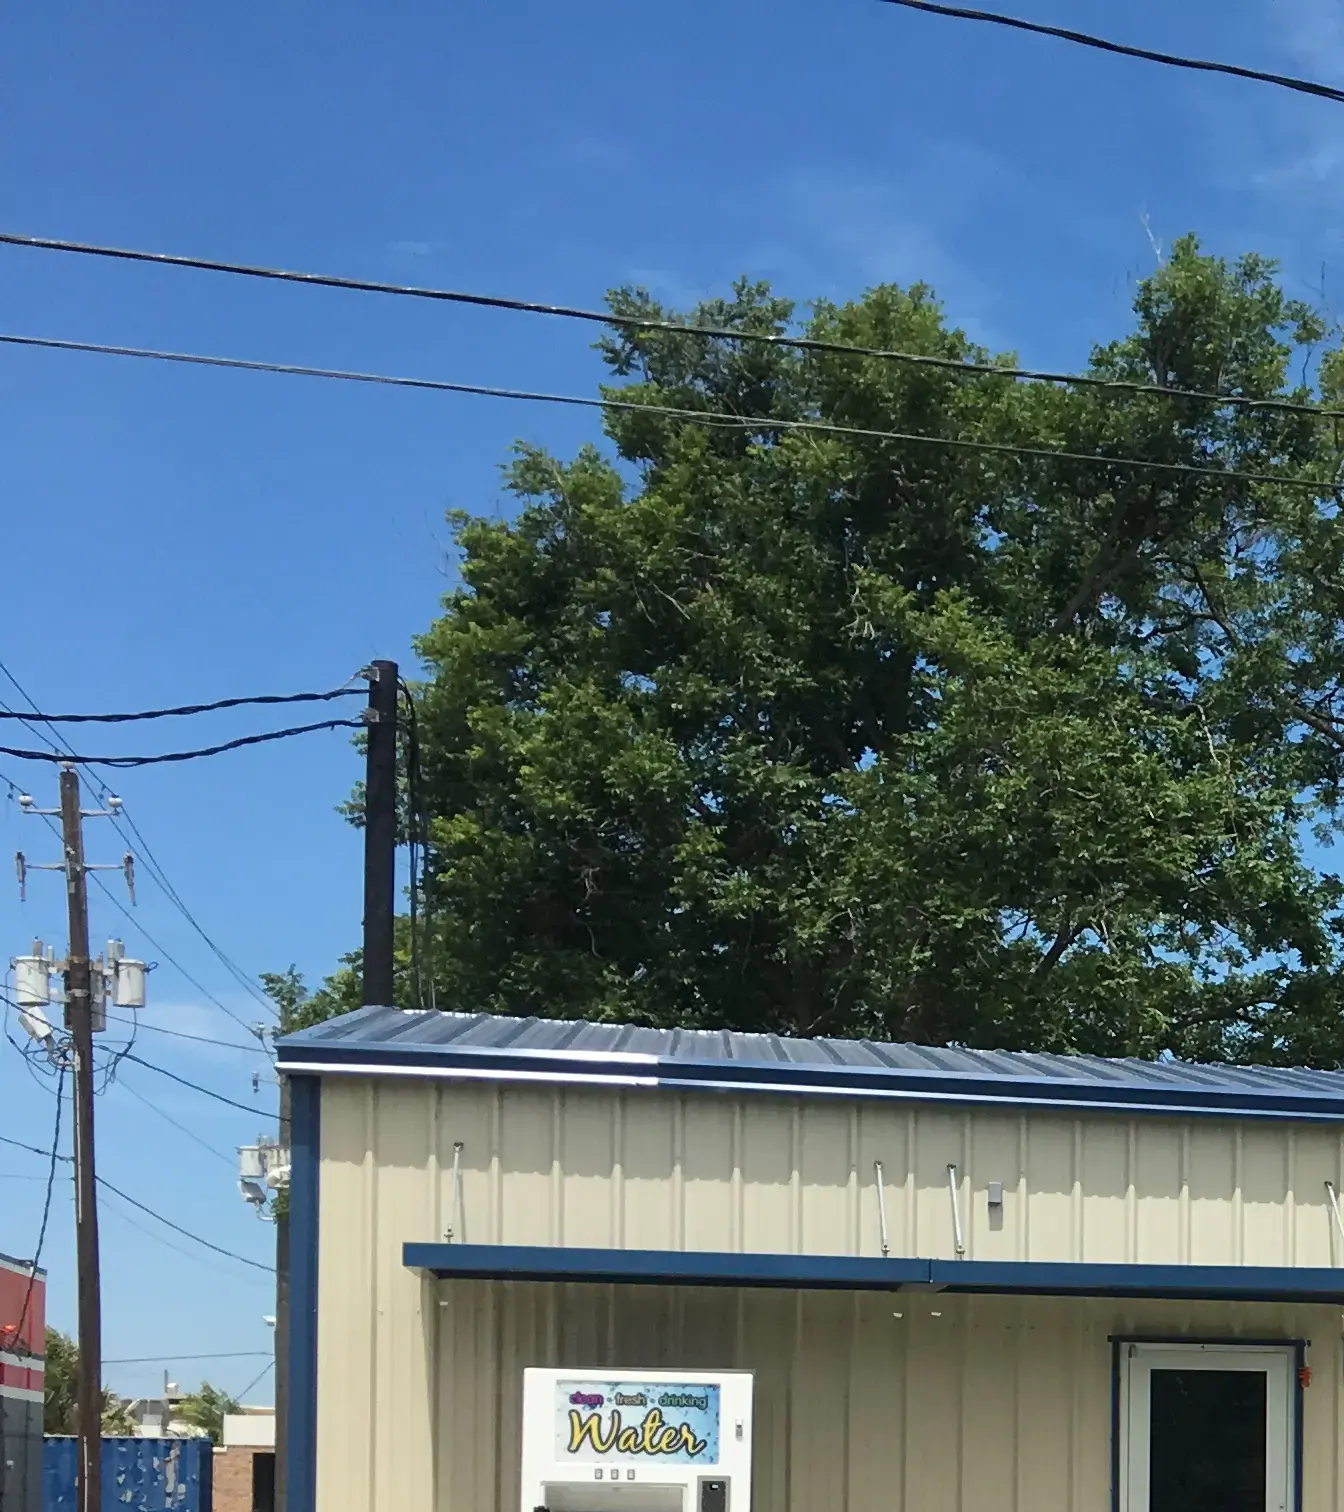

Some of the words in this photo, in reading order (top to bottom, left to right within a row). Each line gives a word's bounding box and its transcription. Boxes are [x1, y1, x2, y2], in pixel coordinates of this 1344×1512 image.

[614, 1392, 647, 1406] fresh
[658, 1392, 708, 1410] drinking
[567, 1407, 707, 1457] Water
